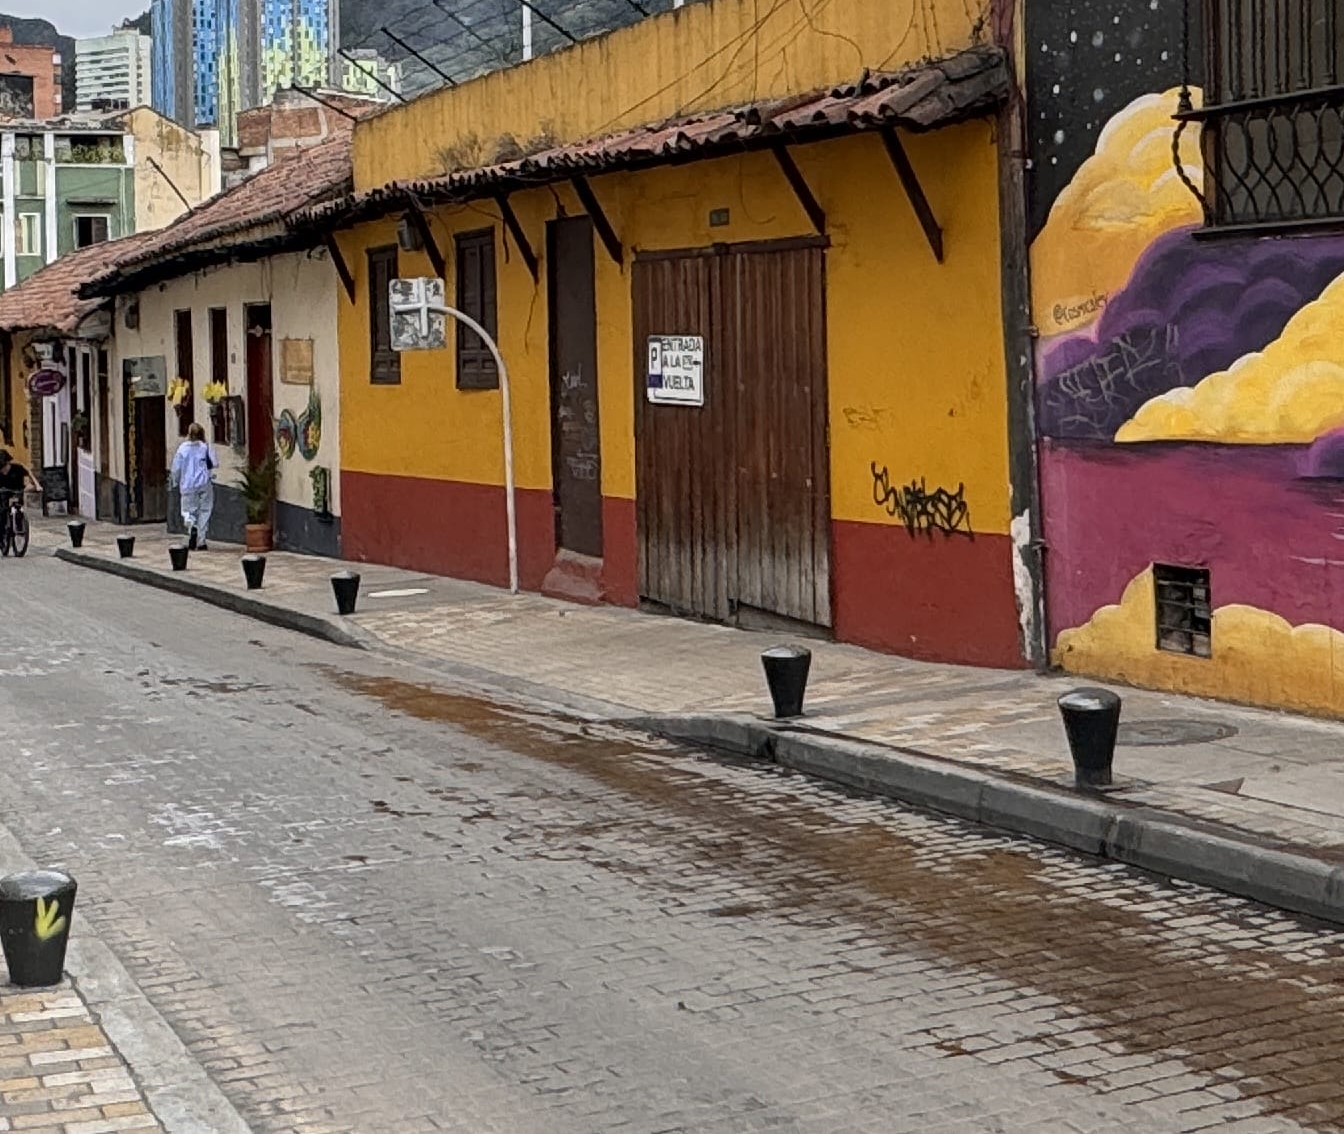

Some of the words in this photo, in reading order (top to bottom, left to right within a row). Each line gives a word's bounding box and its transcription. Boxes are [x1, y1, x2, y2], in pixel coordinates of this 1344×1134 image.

[662, 337, 701, 352] ENTRADA
[662, 354, 669, 368] A
[670, 354, 682, 368] LA
[663, 375, 695, 390] VUELTA
